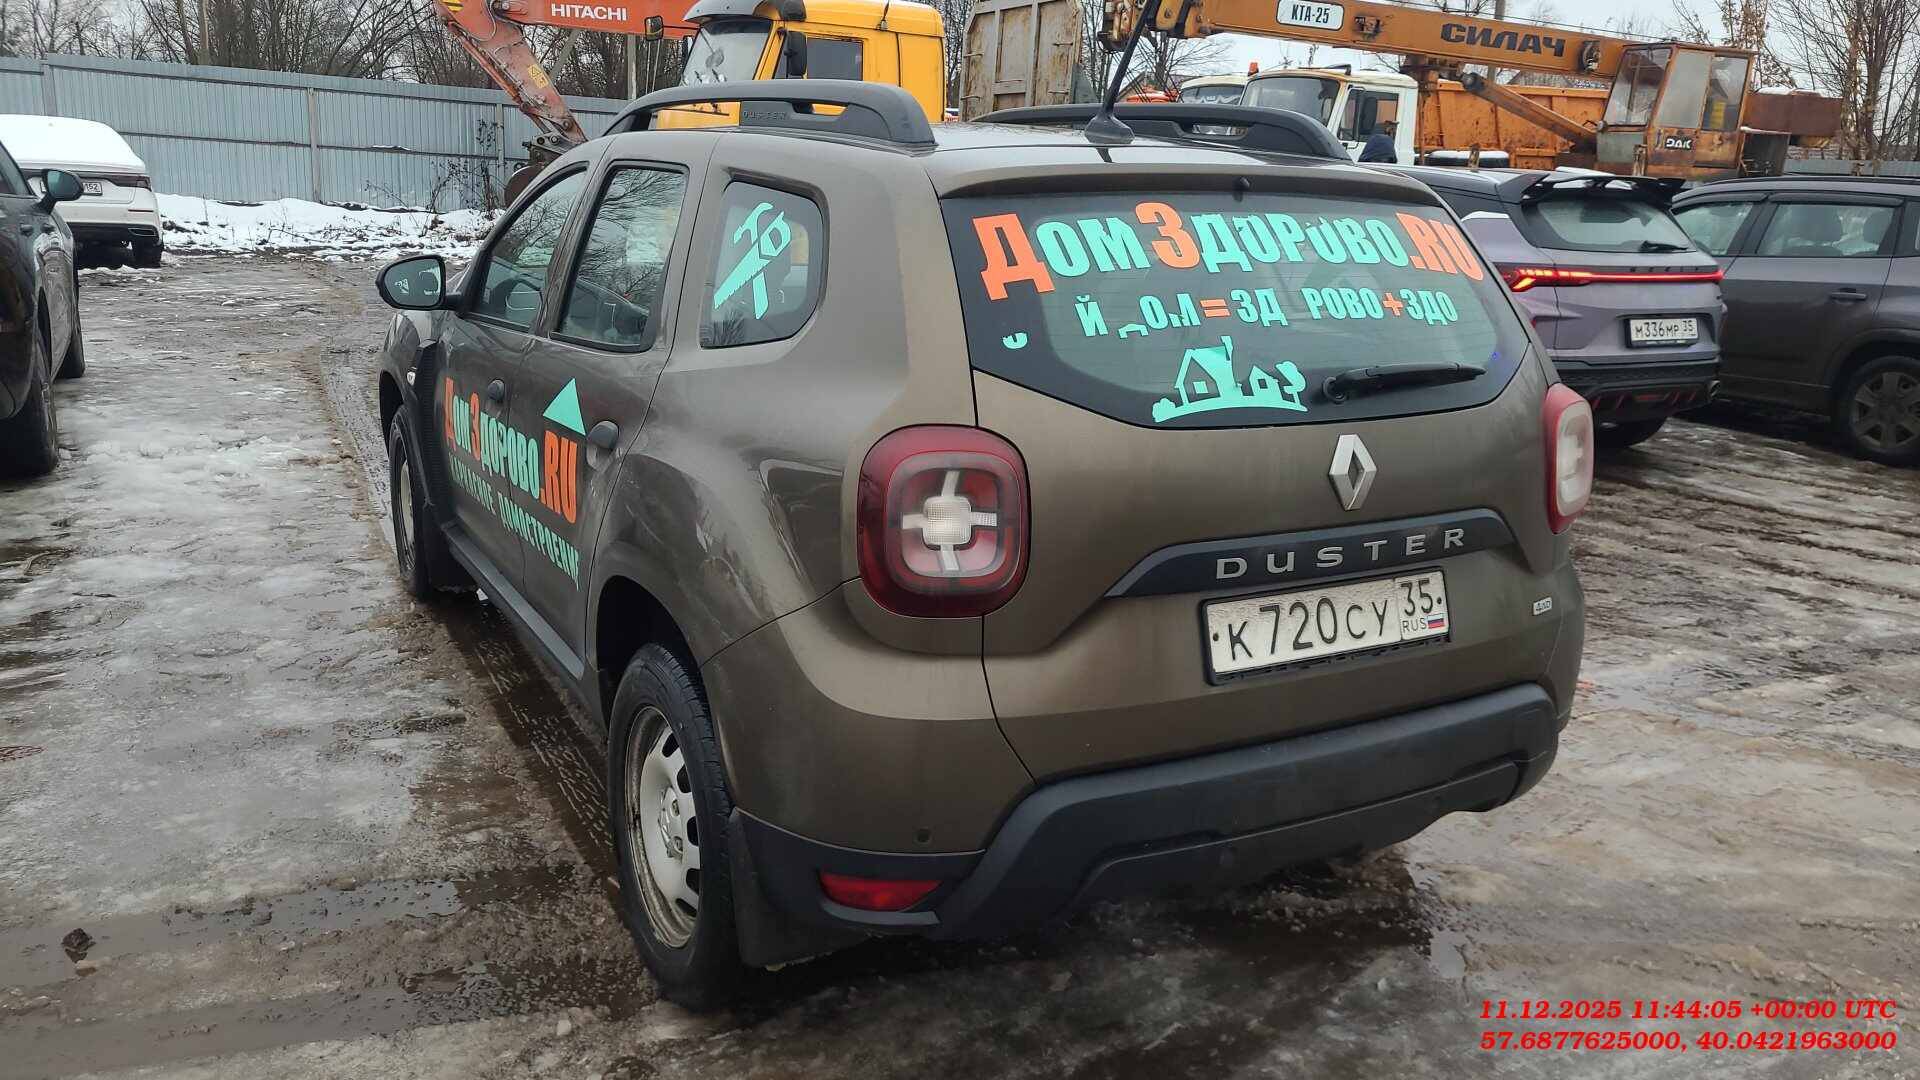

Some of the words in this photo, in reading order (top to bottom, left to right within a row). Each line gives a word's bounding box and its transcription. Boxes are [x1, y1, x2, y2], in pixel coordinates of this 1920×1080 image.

[551, 3, 627, 21] HITACHI
[1441, 23, 1566, 57] СИЛАЧ
[1215, 528, 1465, 580] DUSTER
[1400, 578, 1433, 615] 35
[1402, 616, 1427, 632] RUS
